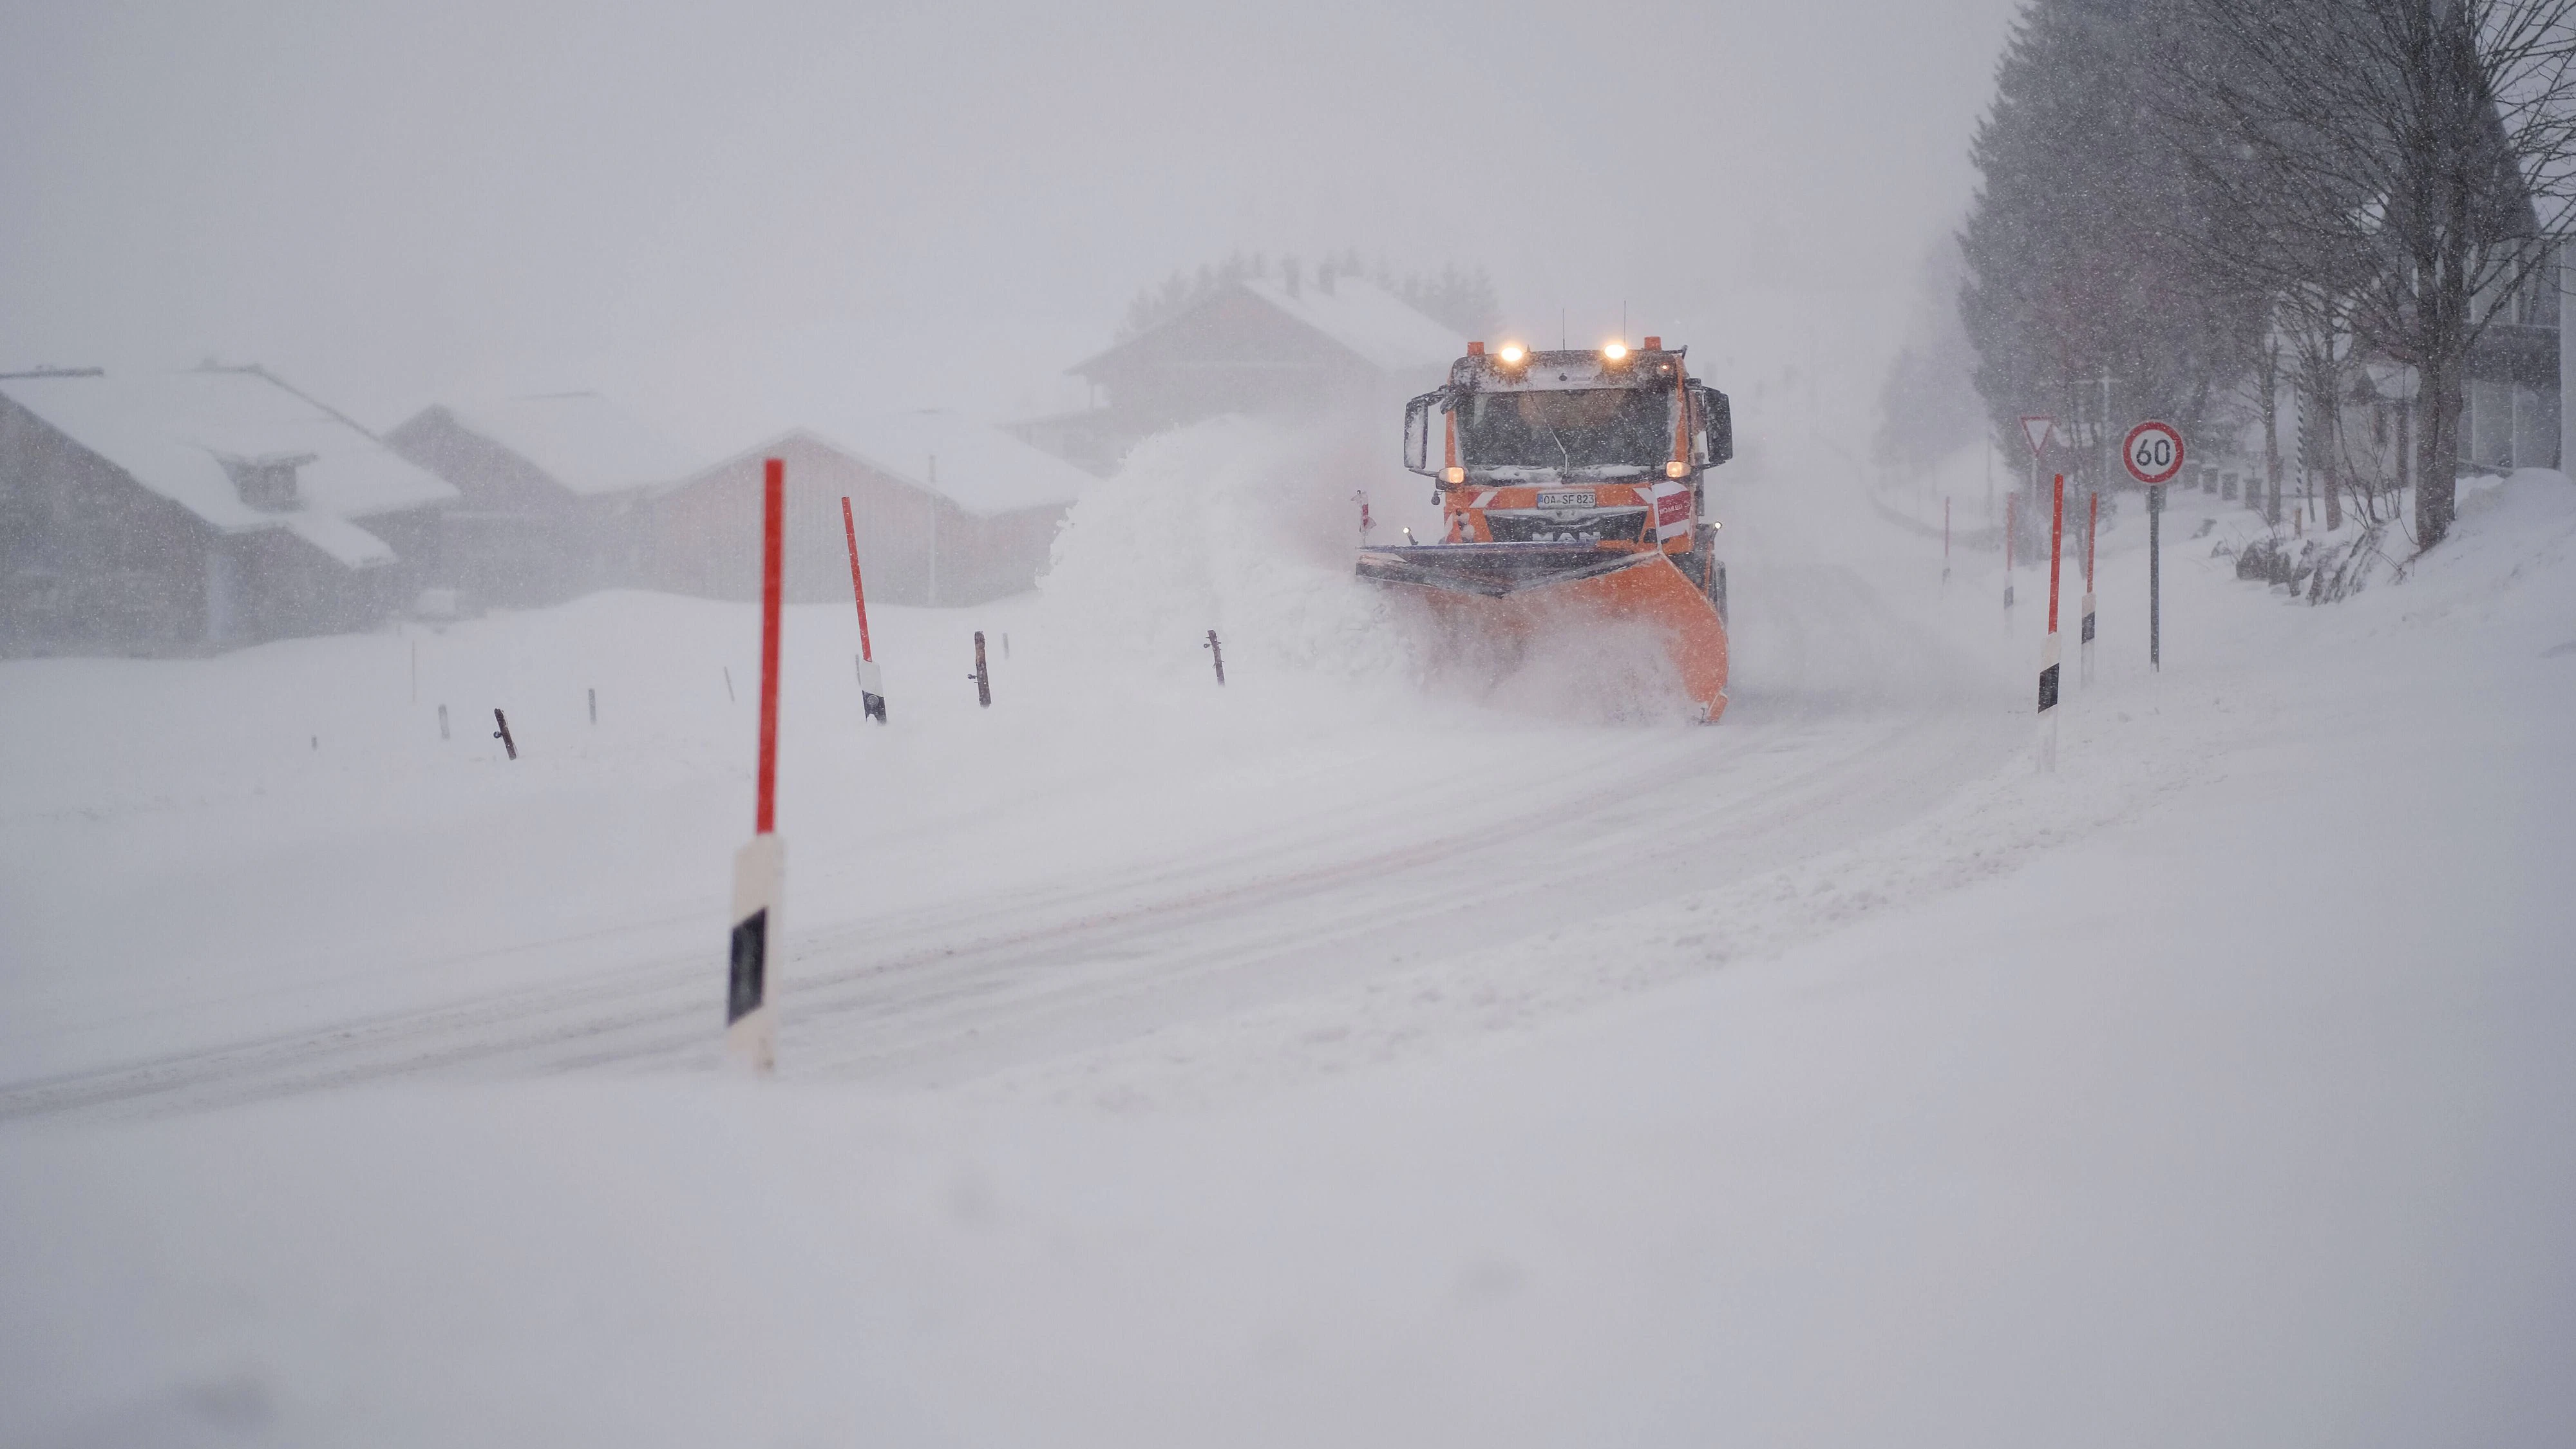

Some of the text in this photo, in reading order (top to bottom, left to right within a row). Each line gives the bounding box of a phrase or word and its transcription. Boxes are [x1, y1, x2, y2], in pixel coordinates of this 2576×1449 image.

[2136, 439, 2170, 466] 60
[1562, 495, 1574, 504] SF
[1577, 494, 1594, 504] 823
[1532, 531, 1601, 542] MAN
